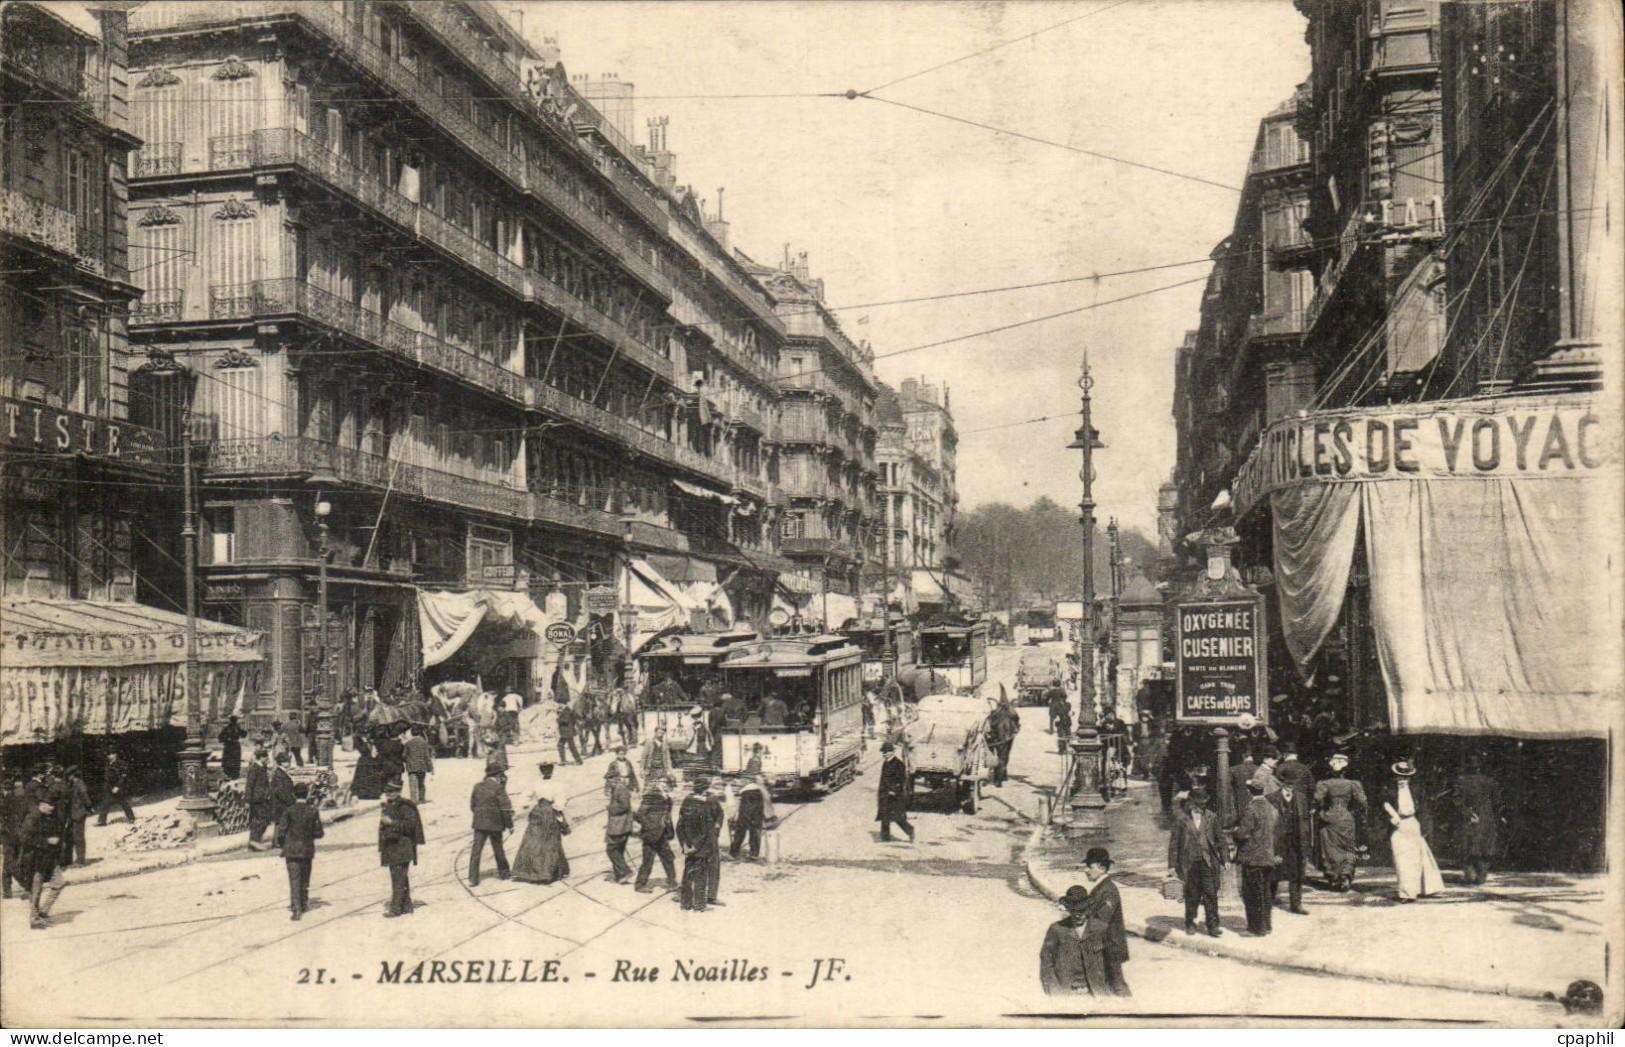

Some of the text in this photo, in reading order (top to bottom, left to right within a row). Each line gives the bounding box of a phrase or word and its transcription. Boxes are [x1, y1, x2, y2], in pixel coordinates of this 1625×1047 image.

[1366, 418, 1420, 473] DE
[1183, 608, 1250, 632] OXYGÉNÉE
[1183, 637, 1253, 658] CUSENIER
[1224, 695, 1251, 710] BARS
